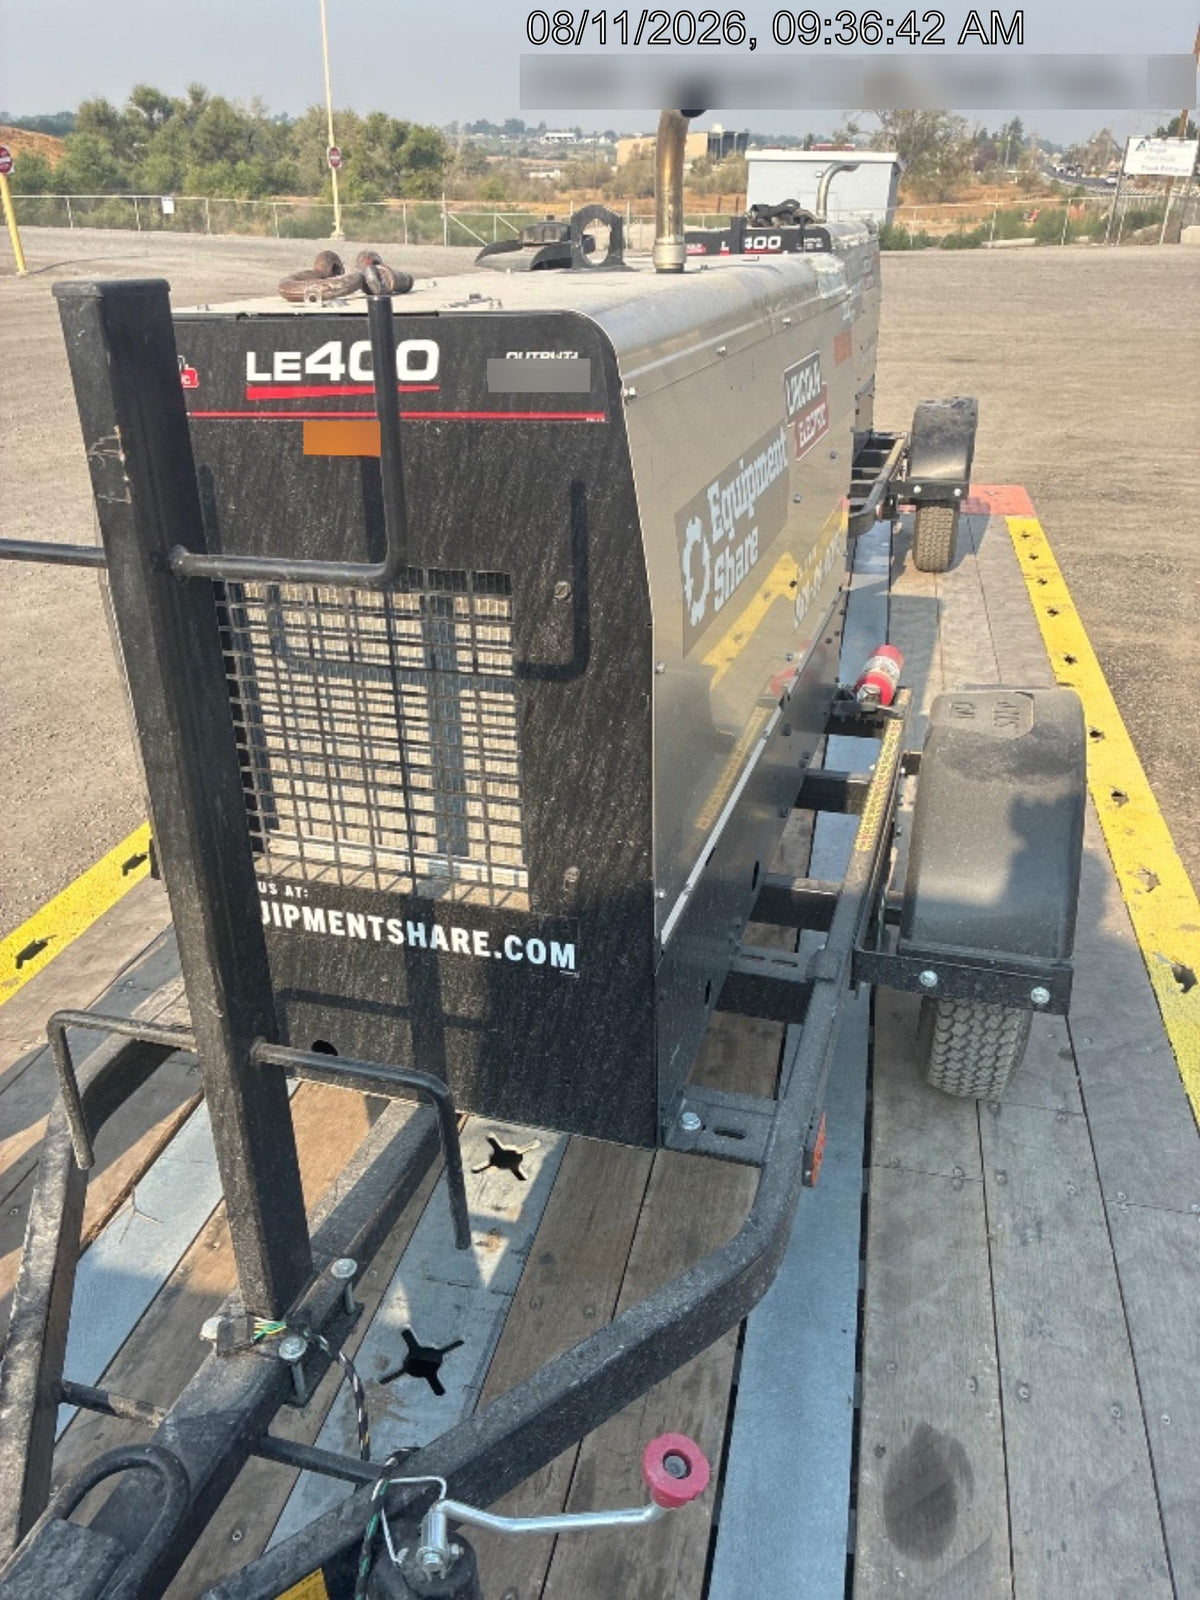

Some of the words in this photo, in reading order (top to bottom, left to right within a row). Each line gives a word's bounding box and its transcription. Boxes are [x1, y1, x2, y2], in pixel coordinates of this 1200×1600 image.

[707, 426, 788, 545] Equipment
[257, 881, 278, 895] US
[285, 885, 308, 898] AT:
[261, 899, 576, 970] IPMENTSHARE.COM
